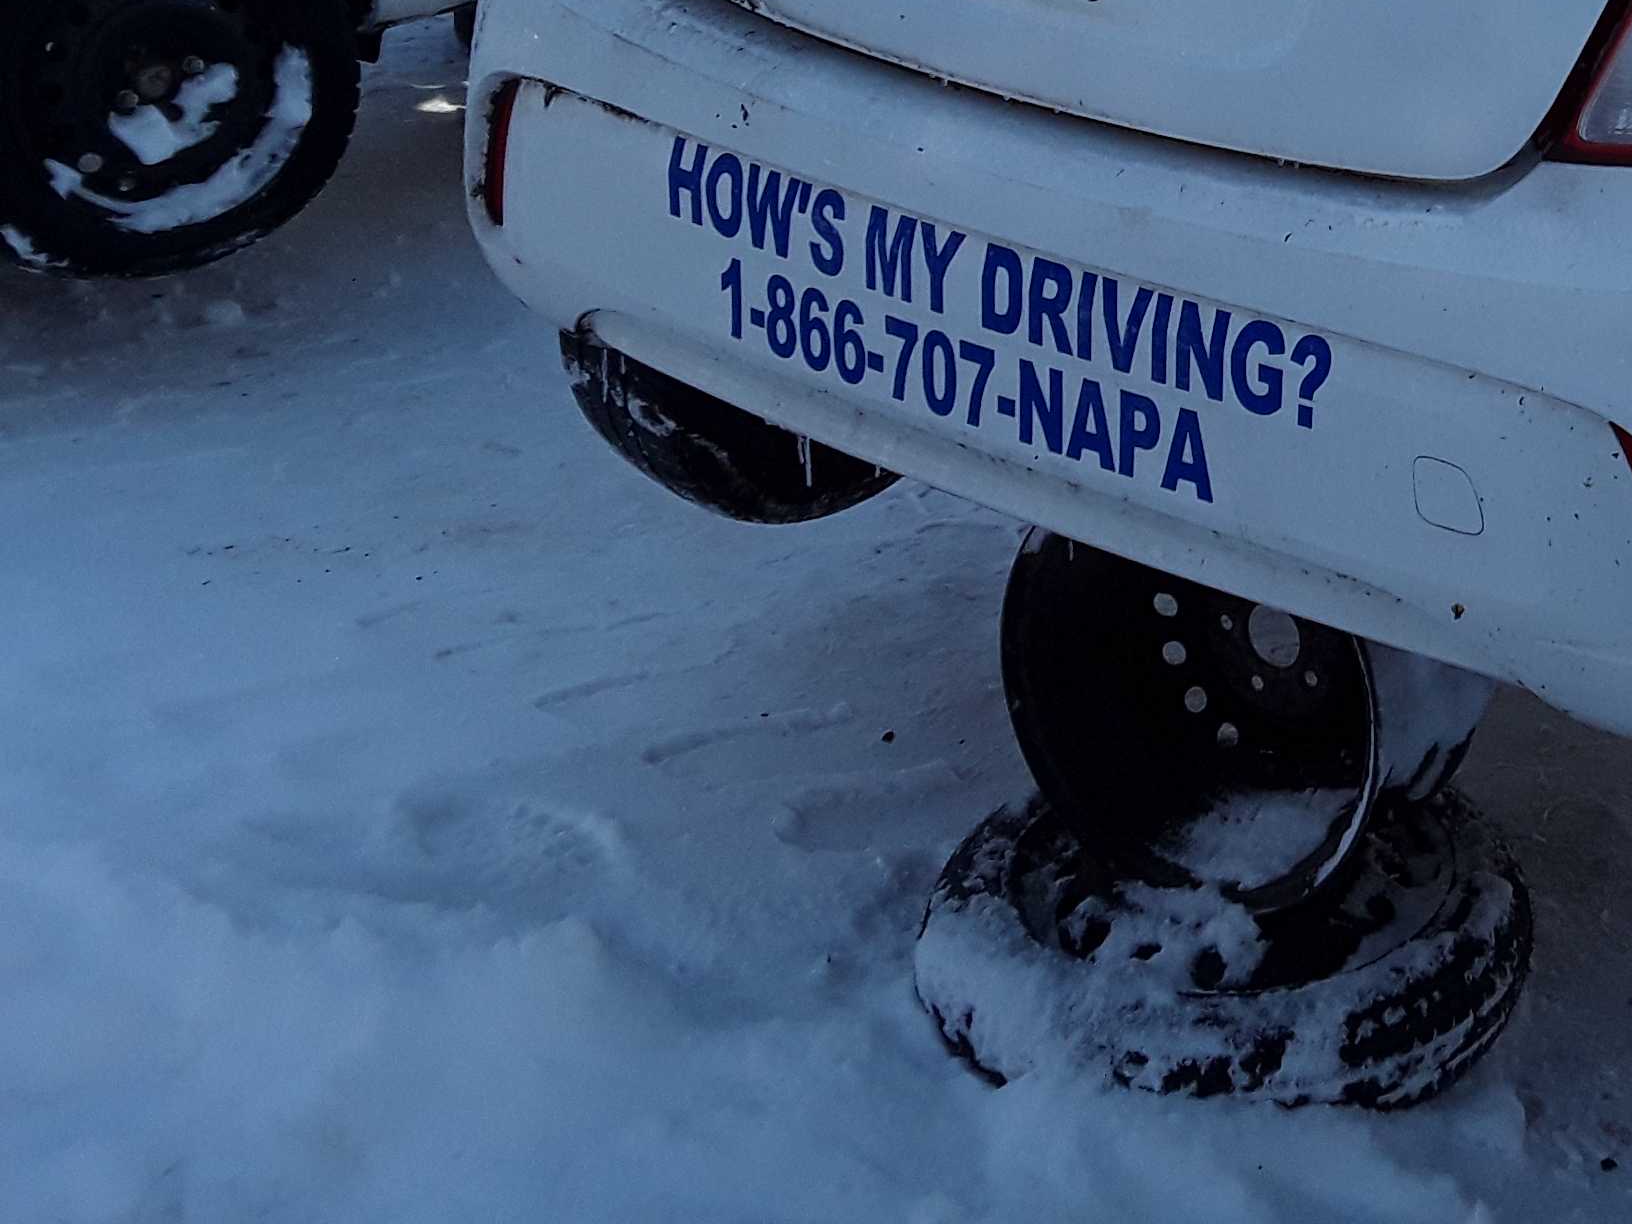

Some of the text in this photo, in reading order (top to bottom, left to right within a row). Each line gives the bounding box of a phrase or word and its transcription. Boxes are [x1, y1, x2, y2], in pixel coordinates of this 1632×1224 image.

[667, 136, 1332, 429] HOW'S MY DRIVING?
[720, 258, 1214, 504] 1-866-707-NAPA
